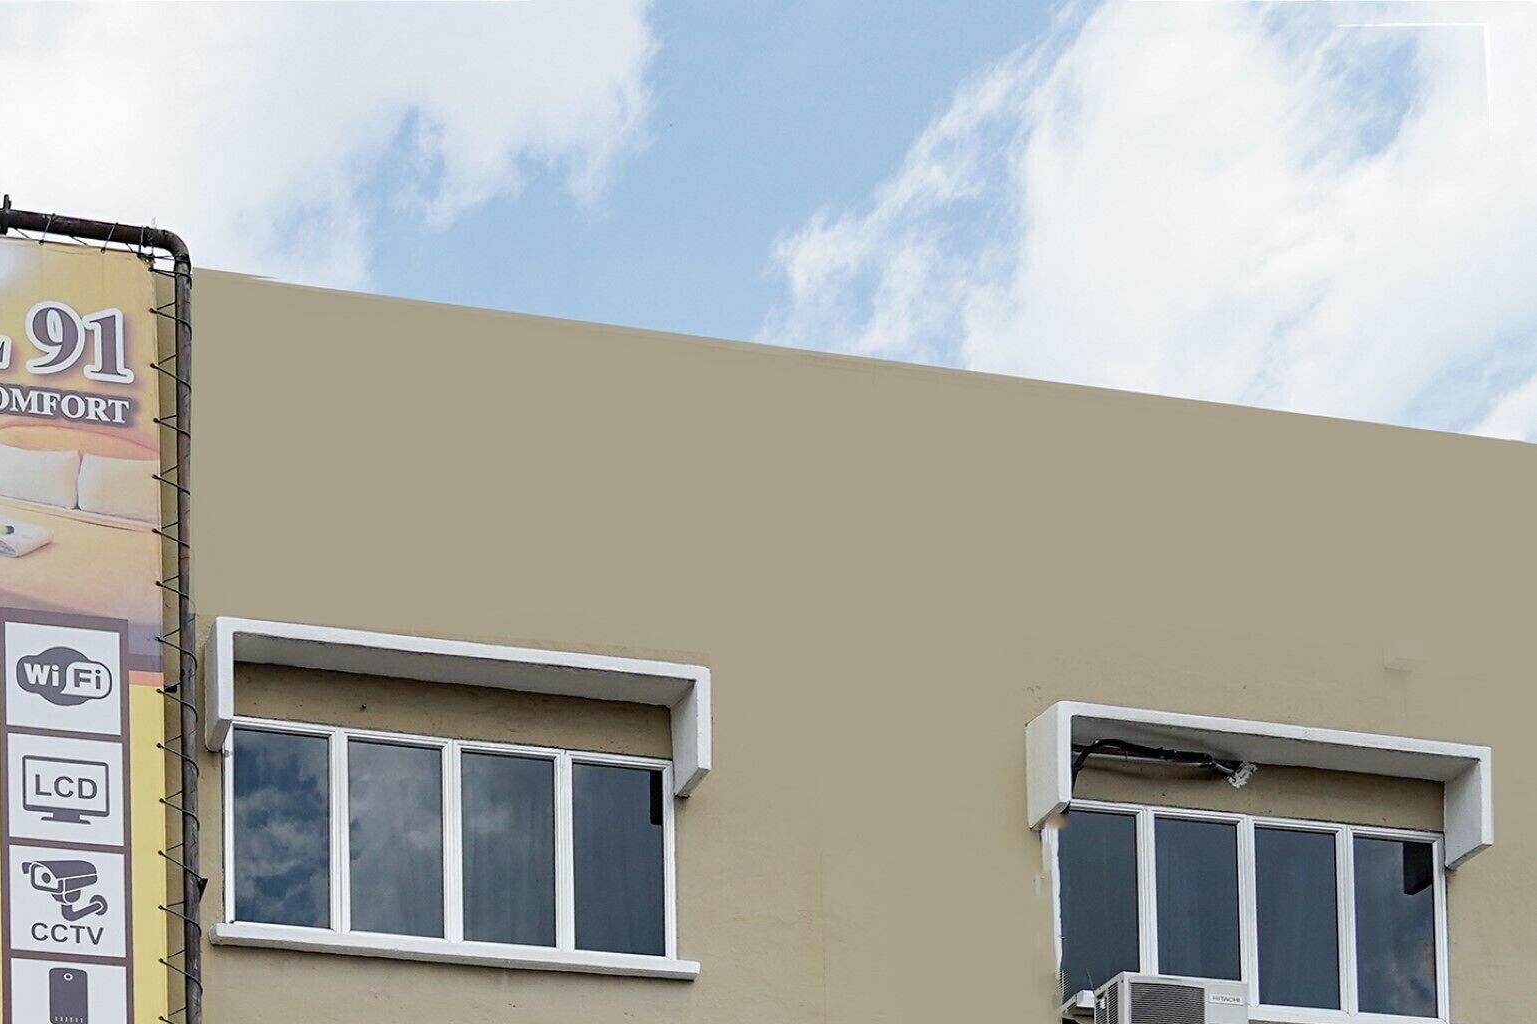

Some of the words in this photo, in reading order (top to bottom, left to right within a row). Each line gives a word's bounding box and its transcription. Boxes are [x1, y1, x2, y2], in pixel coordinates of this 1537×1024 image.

[25, 301, 134, 383] 91
[34, 773, 99, 800] LCD
[30, 922, 104, 945] CCTV
